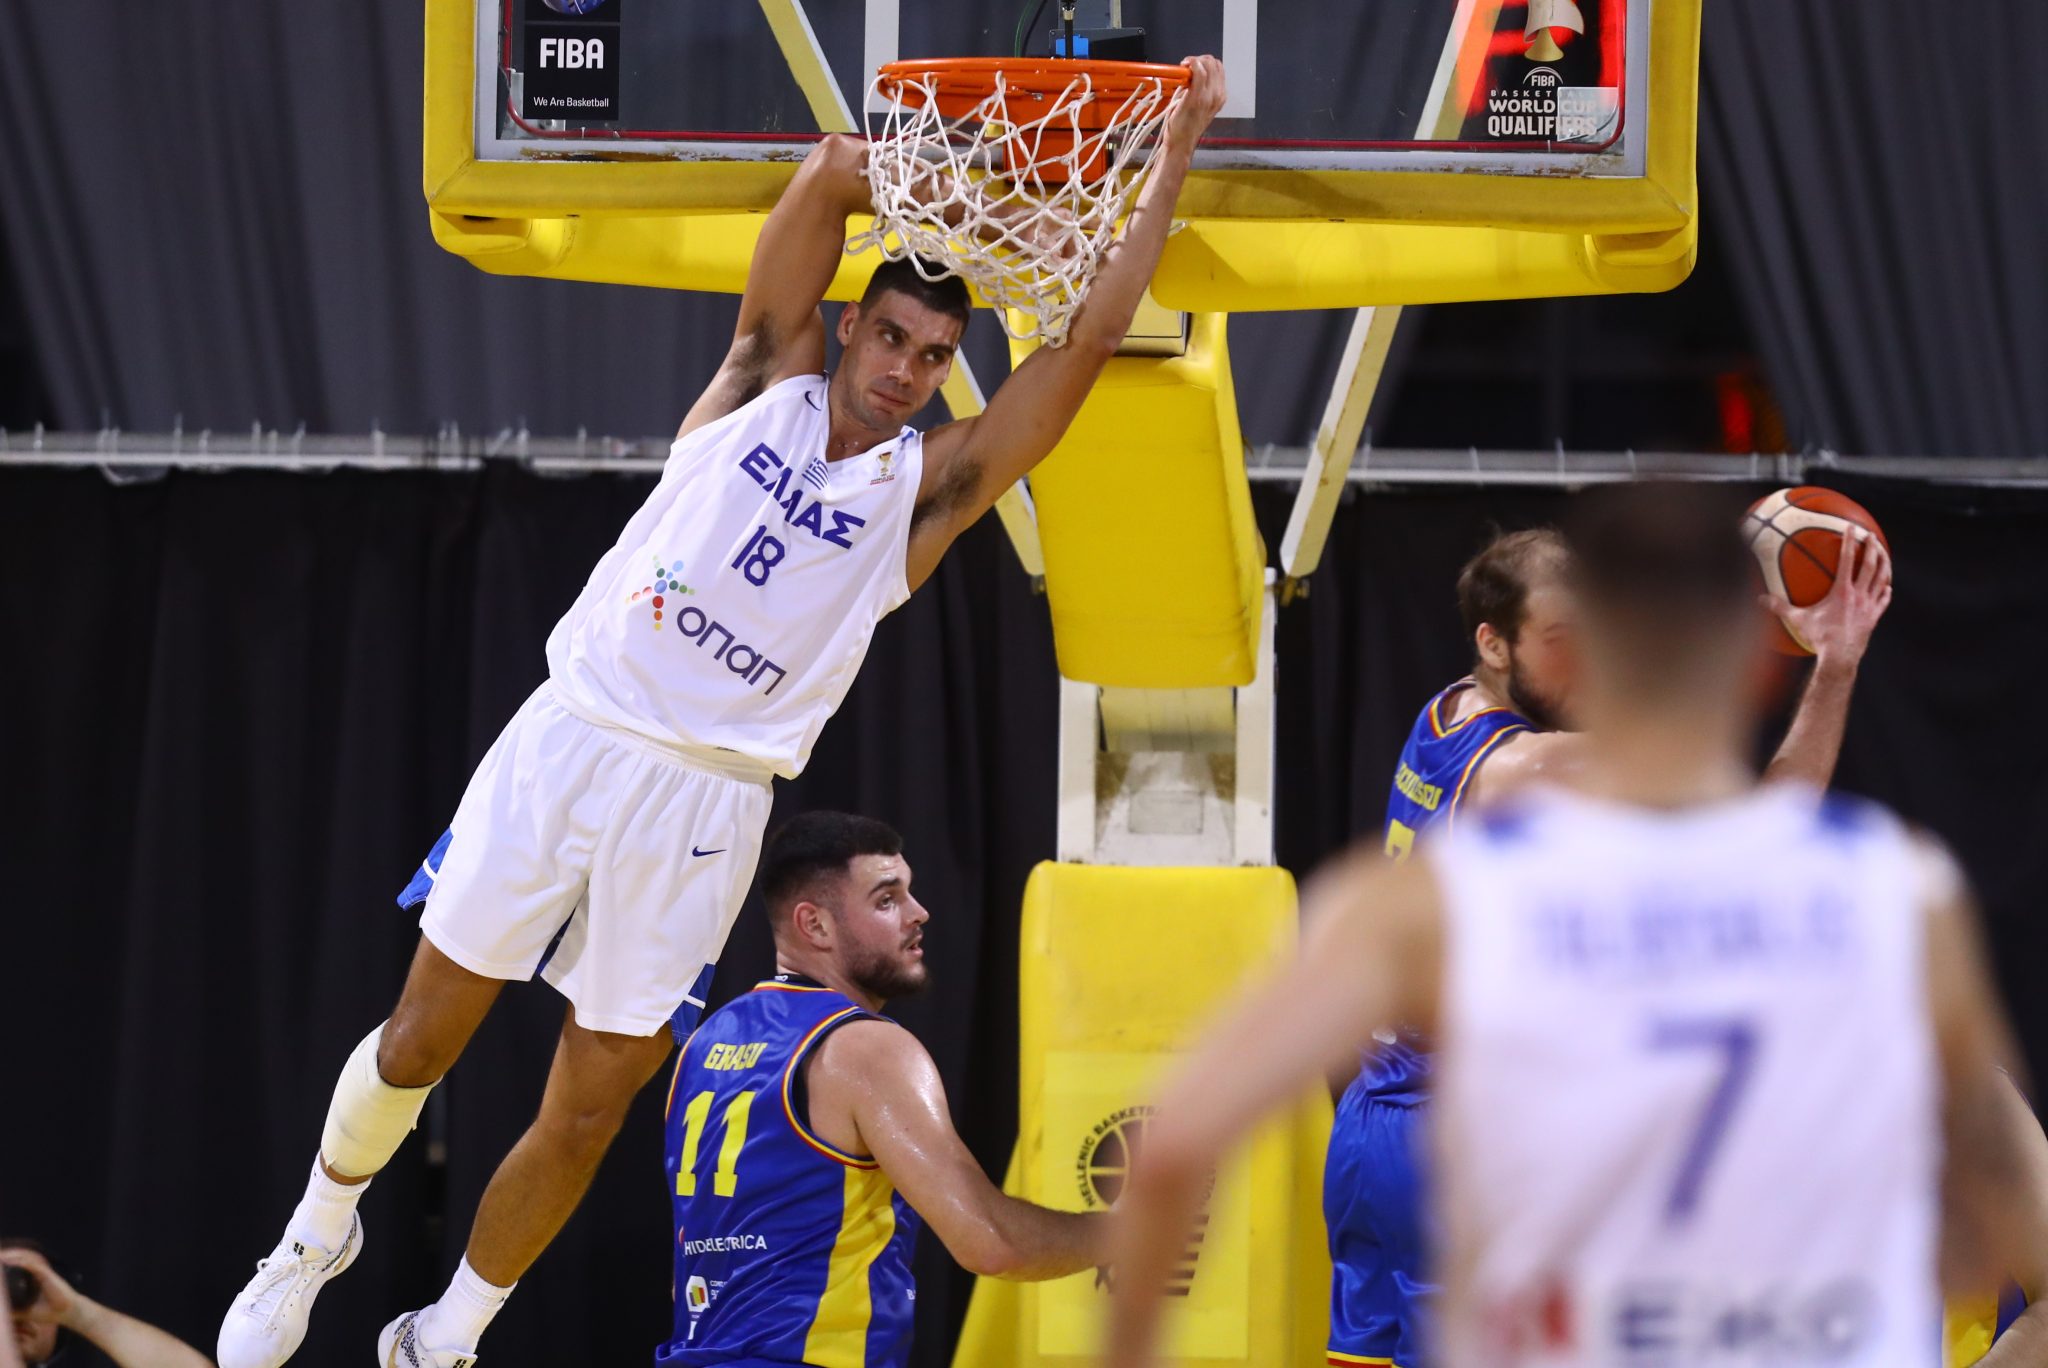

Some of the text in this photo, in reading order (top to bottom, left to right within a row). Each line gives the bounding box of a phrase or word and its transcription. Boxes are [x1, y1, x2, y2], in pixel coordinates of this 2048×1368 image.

[540, 38, 604, 69] FIBA
[1531, 75, 1555, 87] FIBA
[533, 96, 609, 108] We Are Basketball
[1488, 99, 1556, 113] WORLD
[1487, 115, 1598, 137] QUALIFIERS
[731, 524, 786, 587] 18
[703, 1042, 769, 1072] GRASU
[1635, 1010, 1764, 1234] 7
[675, 1090, 756, 1198] 11
[1076, 1136, 1096, 1207] HELLENIC
